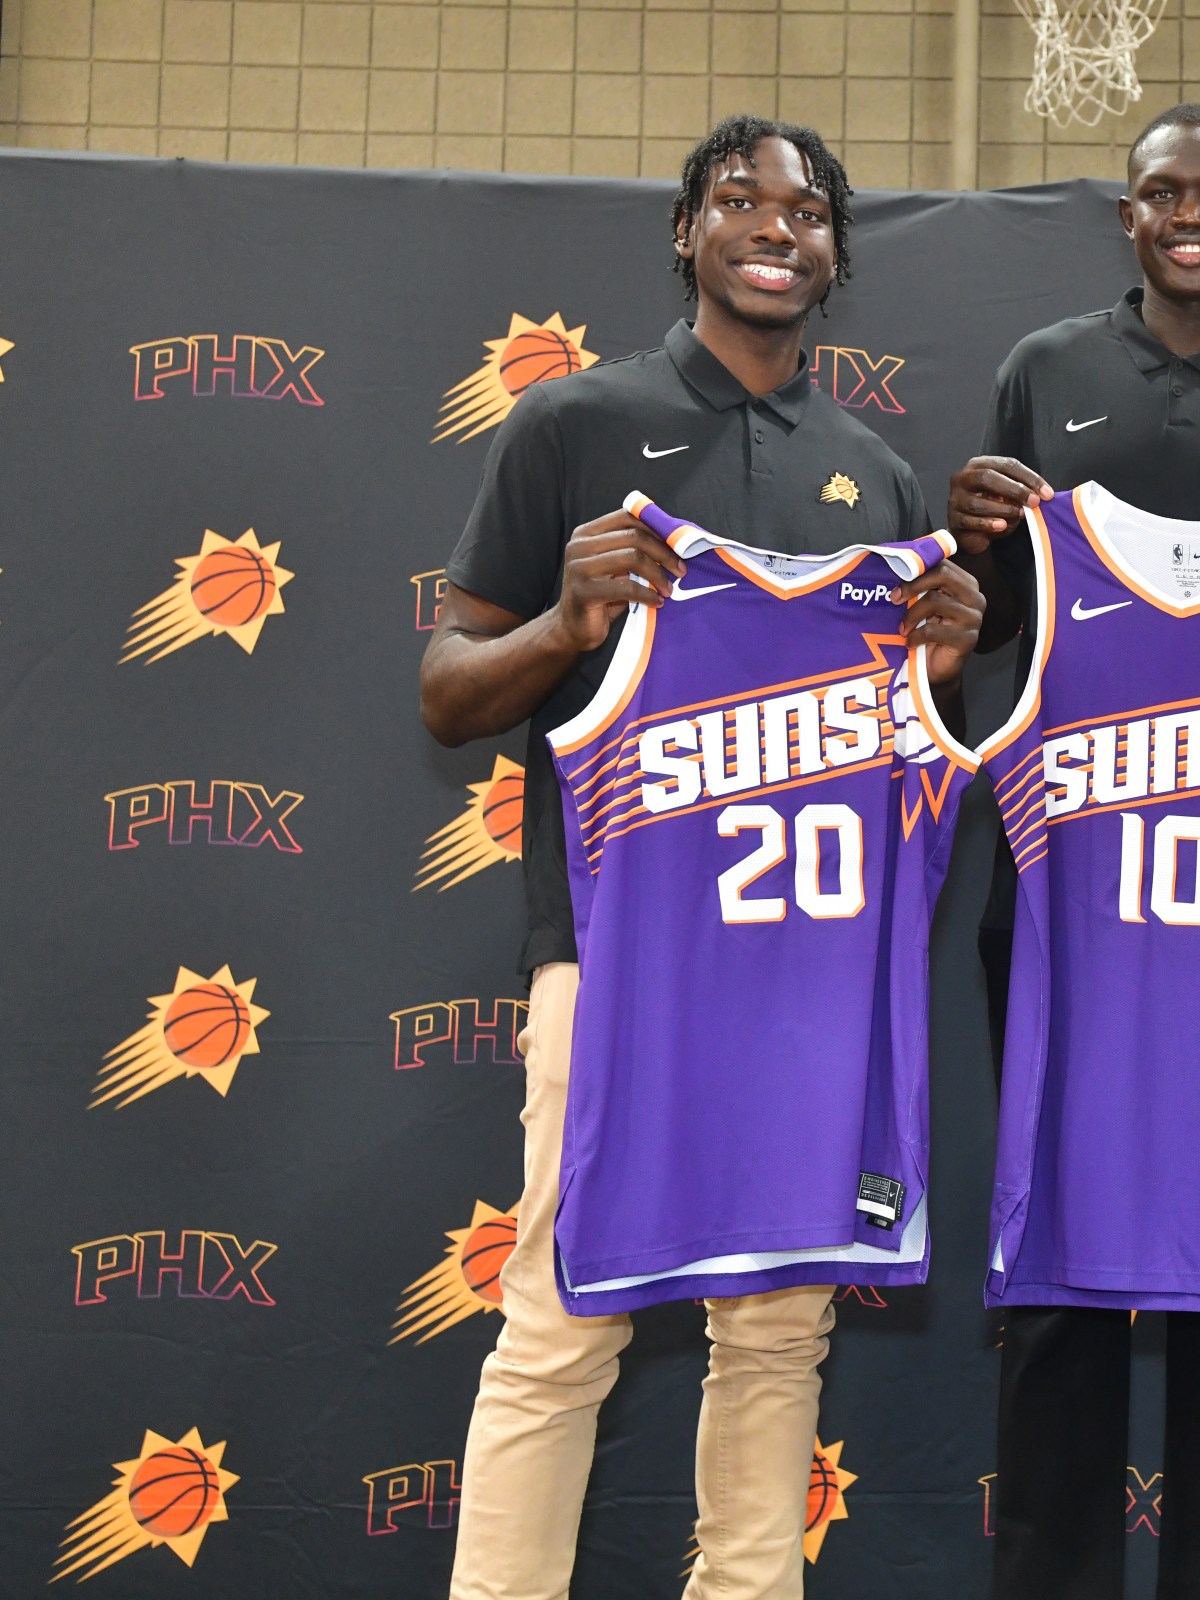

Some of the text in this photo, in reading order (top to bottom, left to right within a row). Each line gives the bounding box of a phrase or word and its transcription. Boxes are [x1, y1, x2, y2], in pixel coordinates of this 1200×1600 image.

[129, 334, 326, 406] PHX
[840, 582, 892, 606] PayPa
[104, 779, 304, 854] PHX
[717, 804, 866, 924] 20
[388, 998, 530, 1070] PH
[70, 1230, 278, 1307] PHX
